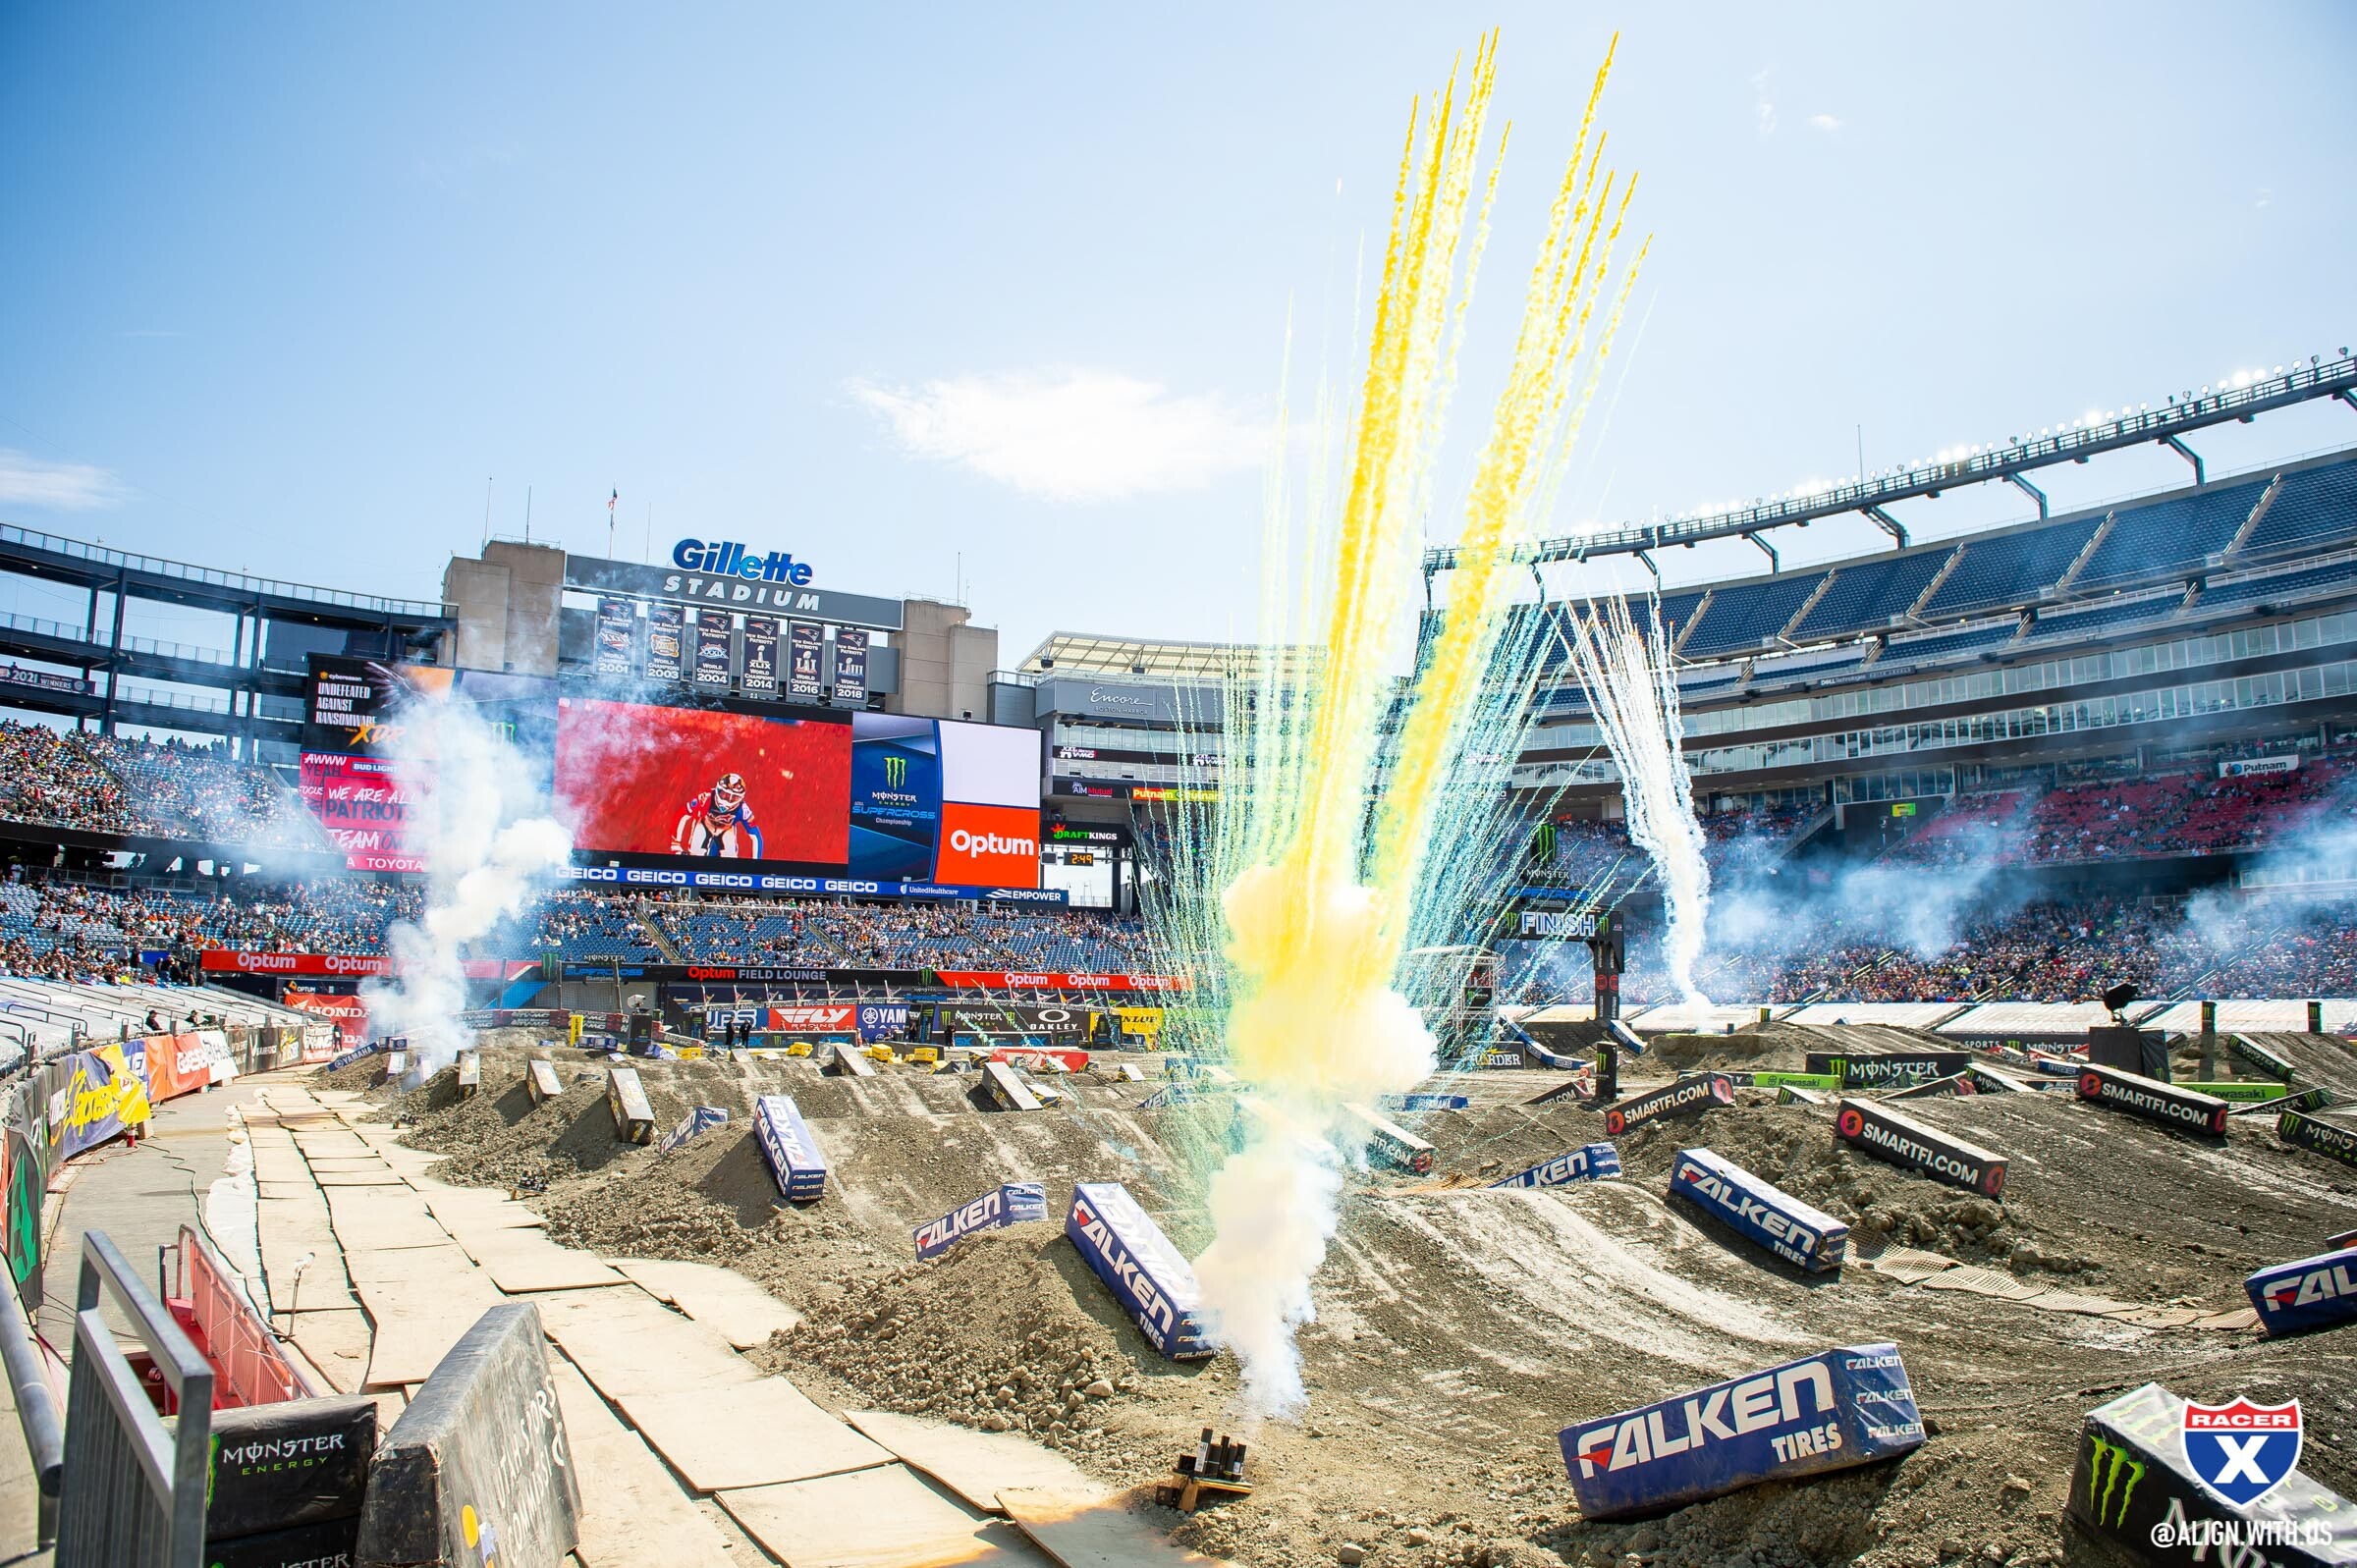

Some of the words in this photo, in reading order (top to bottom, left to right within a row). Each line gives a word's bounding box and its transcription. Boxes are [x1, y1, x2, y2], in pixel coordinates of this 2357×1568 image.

[674, 539, 812, 586] Gillette
[664, 576, 819, 611] STADIUM
[12, 670, 38, 683] 2021
[598, 664, 628, 674] 2001
[648, 669, 679, 679] 2003
[40, 677, 73, 689] WINNERS
[696, 674, 727, 684] 2004
[746, 678, 773, 689] 2014
[317, 681, 370, 699] UNDEFEATED
[792, 684, 818, 694] 2016
[838, 689, 862, 698] 2018
[1091, 686, 1153, 706] Encore
[317, 697, 354, 712] AGAINST
[315, 711, 377, 728] RANSOMWARE
[304, 753, 347, 766] AWWW
[2244, 761, 2286, 773] Putnam
[373, 764, 398, 773] LIGHT
[328, 785, 351, 800] WE
[354, 787, 386, 802] ARE
[872, 791, 917, 802] MONSTER
[1132, 788, 1174, 800] Putnam
[324, 799, 417, 822] PATRIOTS
[851, 806, 936, 820] SUPERCROSS
[950, 829, 1035, 858] Optum
[1053, 830, 1119, 841] DRAFTKINGS
[366, 857, 424, 871] TOYOTA
[1071, 853, 1093, 865] 2:49
[555, 867, 619, 882] GEICO
[627, 870, 686, 884] GEICO
[695, 873, 753, 887] GEICO
[761, 876, 817, 891] GEICO
[824, 879, 878, 892] GEICO
[908, 886, 959, 895] UnitedHealthcare
[1012, 890, 1062, 901] EMPOWER
[1521, 910, 1595, 938] FINISH
[237, 952, 297, 971] Optum
[325, 955, 383, 974] Optum
[687, 966, 736, 982] Optum
[739, 969, 774, 980] FIELD
[776, 970, 827, 981] LOUNGE
[1004, 973, 1048, 987] Optum
[1068, 974, 1110, 988] Optum
[775, 1007, 851, 1024] FLY
[1965, 1040, 2001, 1049] SPORTS
[341, 1046, 373, 1066] YAMAHA
[1850, 1059, 1940, 1079] MONSTER
[1778, 1077, 1820, 1088] Kawasaki
[2200, 1089, 2267, 1099] Kawasaki
[1623, 1081, 1710, 1124] SMARTFI.COM
[2102, 1083, 2210, 1127] SMARTFI.COM
[2305, 1123, 2357, 1150] MONS
[754, 1105, 791, 1185] FALKEN
[1863, 1123, 1979, 1186] SMARTFI.COM
[1007, 1187, 1043, 1197] FALKEN
[1009, 1203, 1045, 1212] FALKEN
[1677, 1162, 1819, 1253] FALKEN
[916, 1190, 1001, 1253] FALKEN
[1774, 1240, 1807, 1266] TIRES
[1072, 1199, 1174, 1335] FALKEN
[2262, 1265, 2357, 1313] FAL
[1139, 1311, 1166, 1351] TIRES
[1845, 1355, 1903, 1372] FALKEN
[1855, 1388, 1914, 1405] FALKEN
[1572, 1361, 1835, 1480] FALKEN
[1868, 1423, 1924, 1439] FALKEN
[223, 1433, 346, 1465] MONSTER
[1771, 1423, 1842, 1463] TIRES
[242, 1456, 329, 1476] ENERGY
